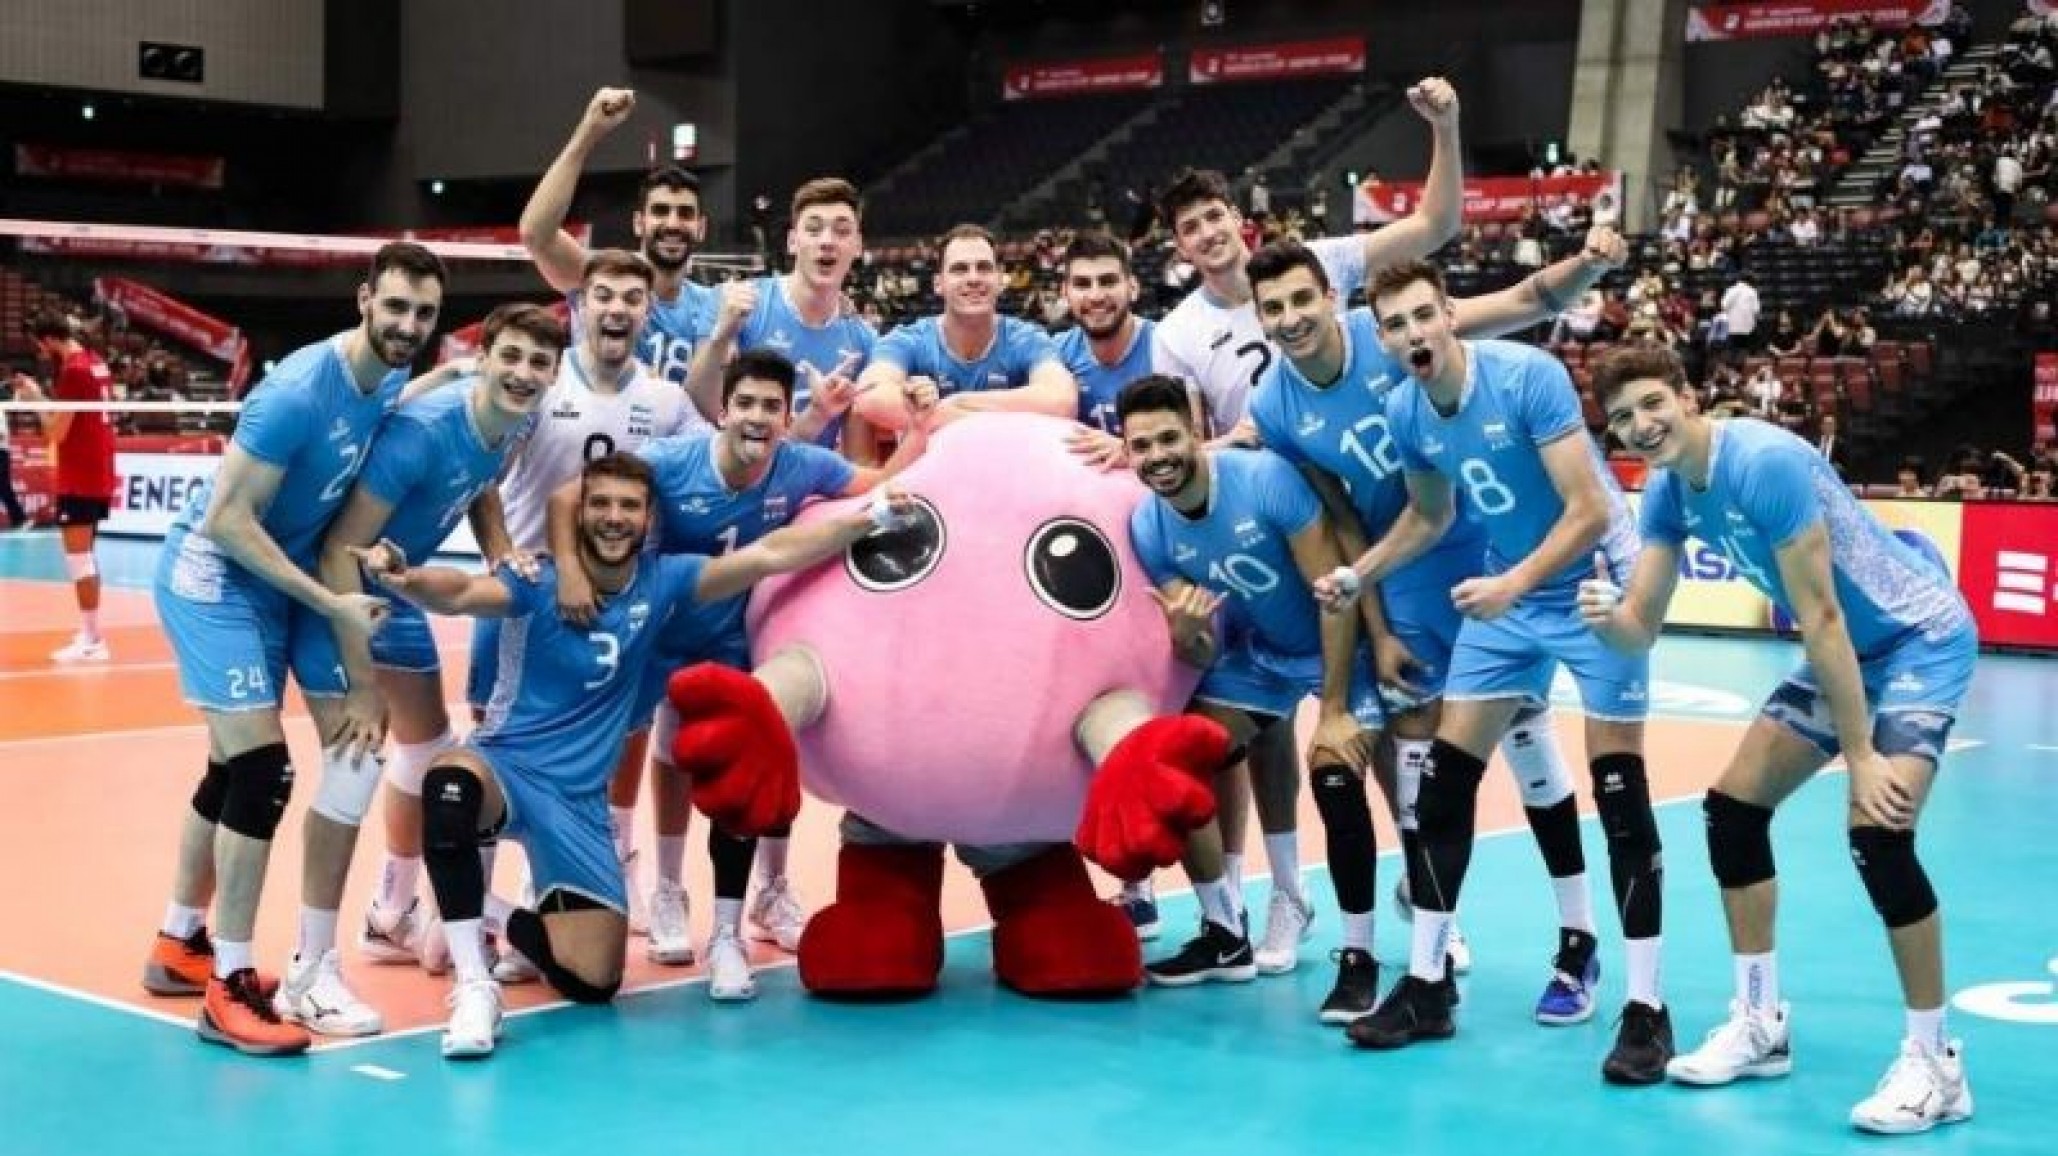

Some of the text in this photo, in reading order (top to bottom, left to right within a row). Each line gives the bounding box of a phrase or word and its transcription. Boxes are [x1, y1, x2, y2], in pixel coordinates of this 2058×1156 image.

[649, 332, 694, 386] 18
[1339, 414, 1403, 480] 12
[1460, 457, 1516, 516] 8
[716, 525, 739, 555] 1
[1208, 554, 1280, 600] 10
[225, 666, 267, 699] 24
[583, 632, 621, 691] 3
